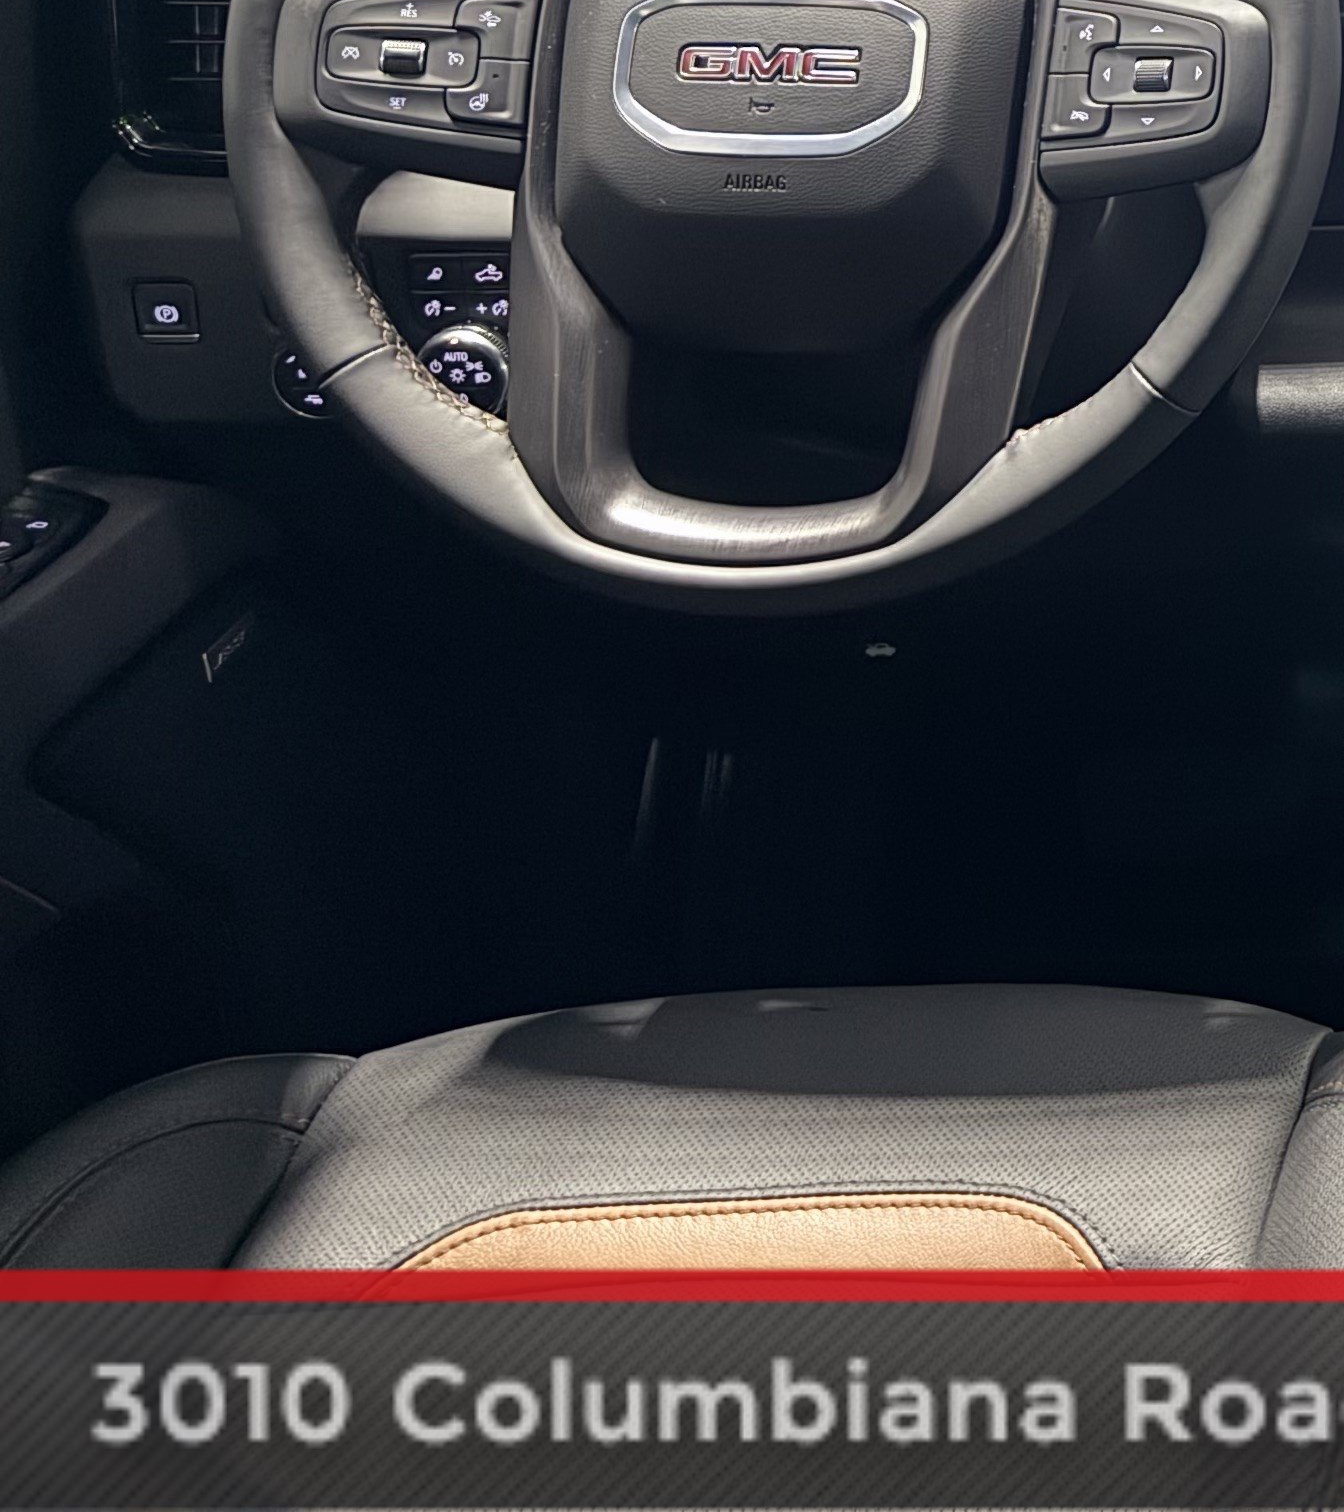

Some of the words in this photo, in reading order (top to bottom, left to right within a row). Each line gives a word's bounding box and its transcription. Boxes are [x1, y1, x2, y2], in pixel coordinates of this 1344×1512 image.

[400, 8, 418, 18] RES
[677, 43, 862, 87] GMC
[389, 96, 406, 107] SET
[723, 174, 787, 192] AIRBAG
[443, 350, 469, 362] AUTO
